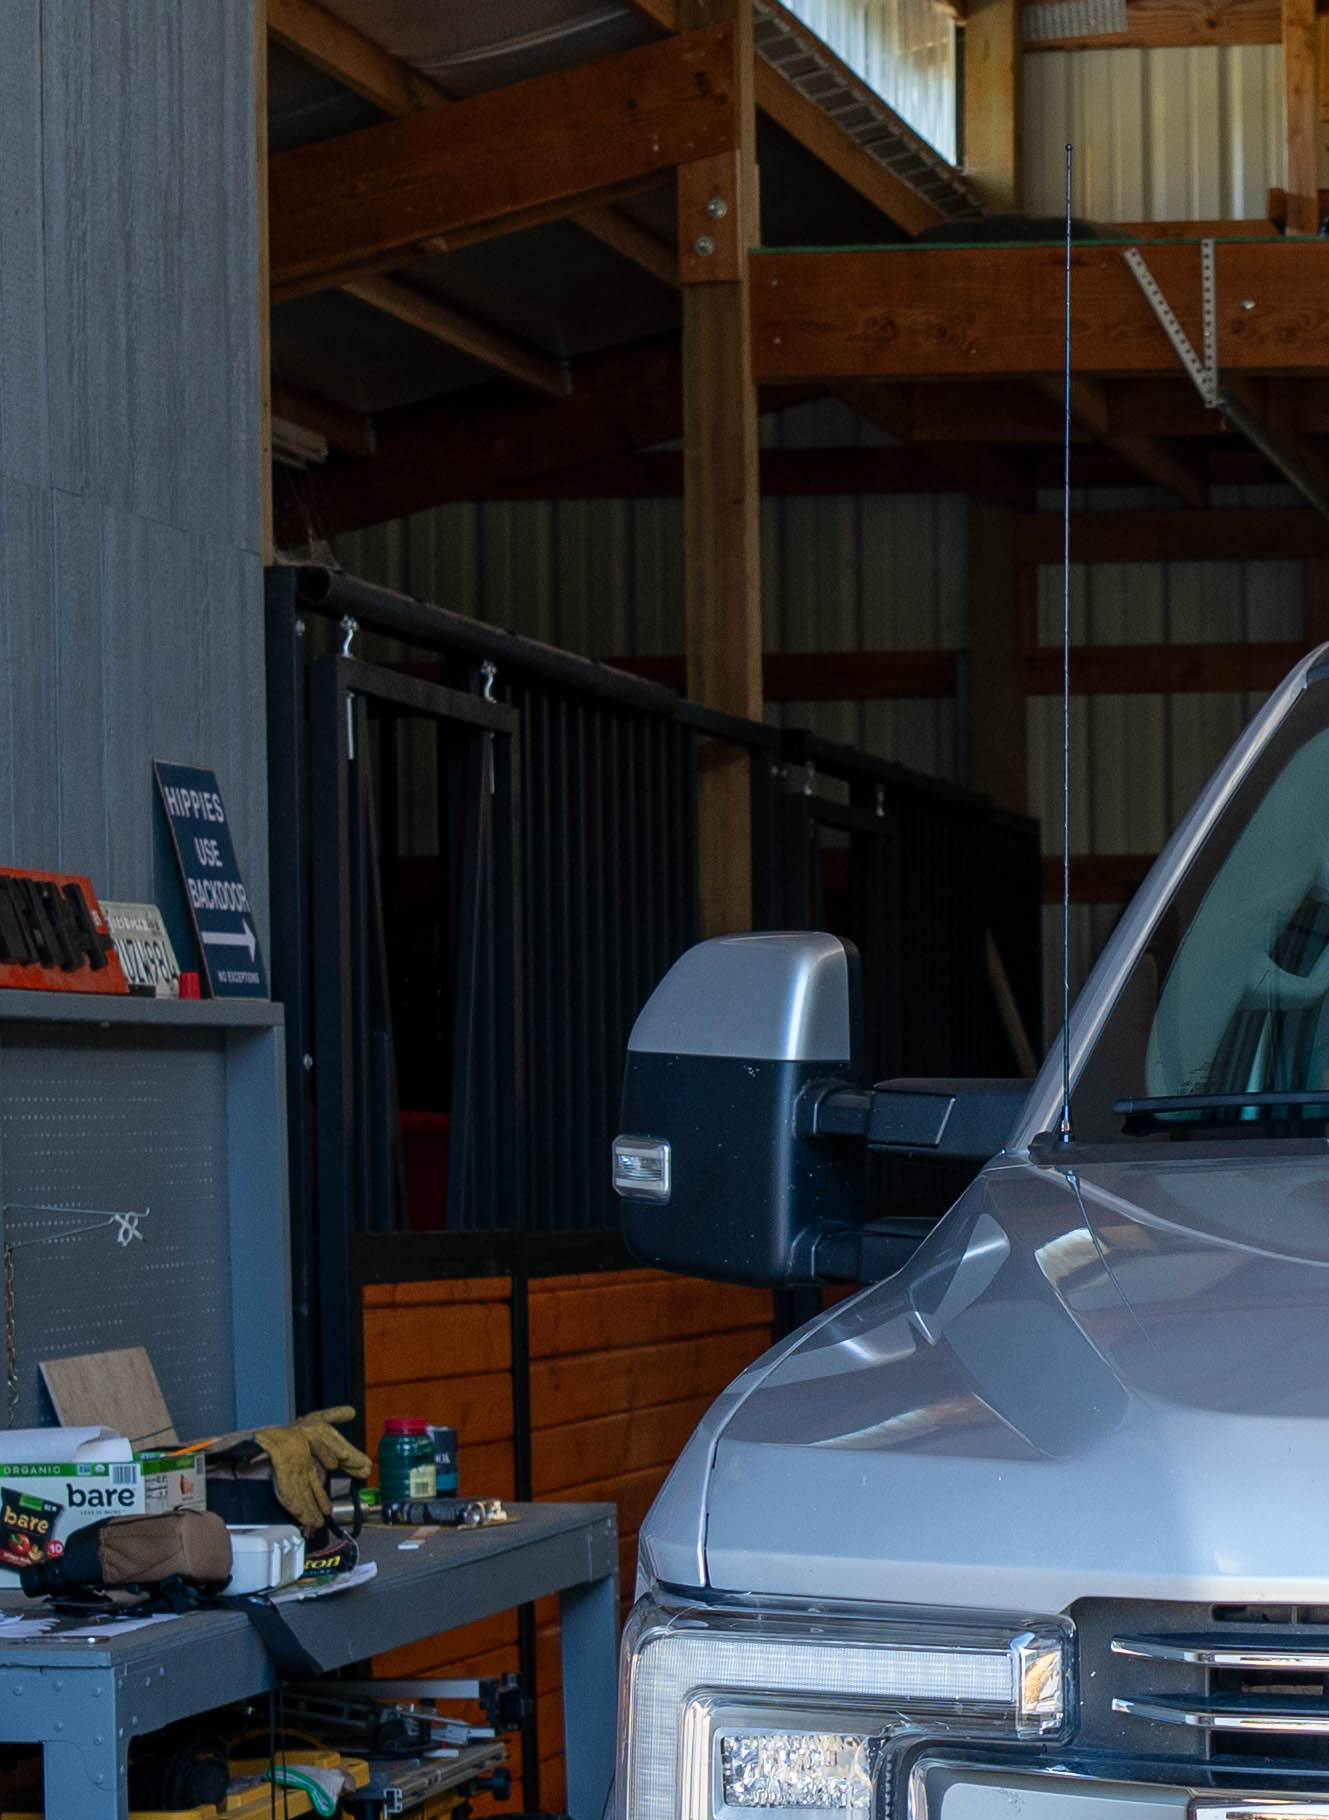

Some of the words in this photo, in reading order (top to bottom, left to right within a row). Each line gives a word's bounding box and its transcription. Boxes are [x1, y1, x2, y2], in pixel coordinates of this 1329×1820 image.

[163, 786, 225, 823] HIPPIES
[194, 837, 224, 867] USE
[187, 878, 251, 914] BACKDOOR
[217, 969, 228, 983] NO
[228, 969, 260, 984] EXCEPTIONS
[3, 1464, 61, 1475] ORGANIC
[66, 1483, 135, 1507] bare
[3, 1504, 50, 1534] bare
[49, 1543, 63, 1554] 10
